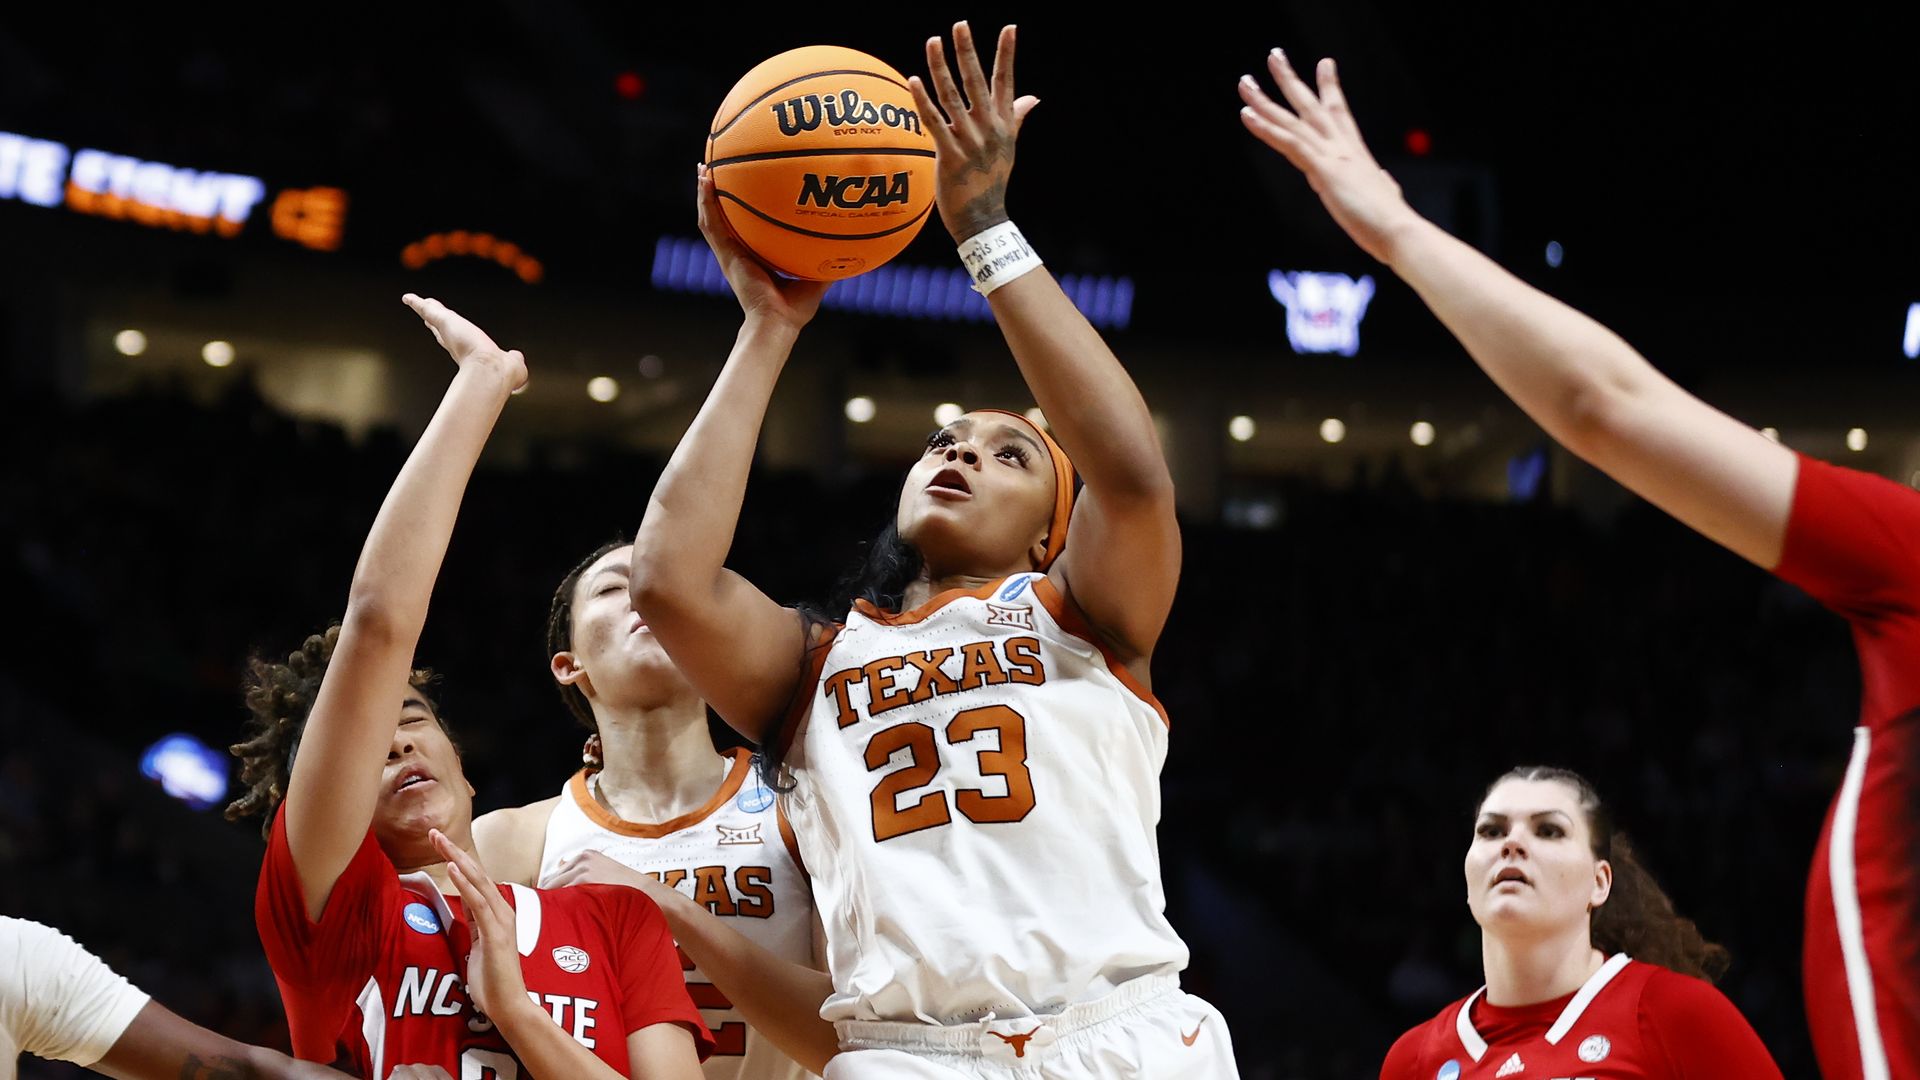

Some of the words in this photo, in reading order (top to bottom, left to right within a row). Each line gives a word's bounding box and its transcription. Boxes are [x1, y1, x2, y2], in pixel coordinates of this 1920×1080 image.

[771, 89, 922, 137] Wilson
[833, 128, 857, 136] EVO
[797, 171, 909, 209] NCAA
[824, 636, 1046, 729] TEXAS
[863, 703, 1037, 843] 23
[407, 913, 438, 931] NCAA
[558, 954, 586, 962] ACC
[393, 966, 463, 1018] NC
